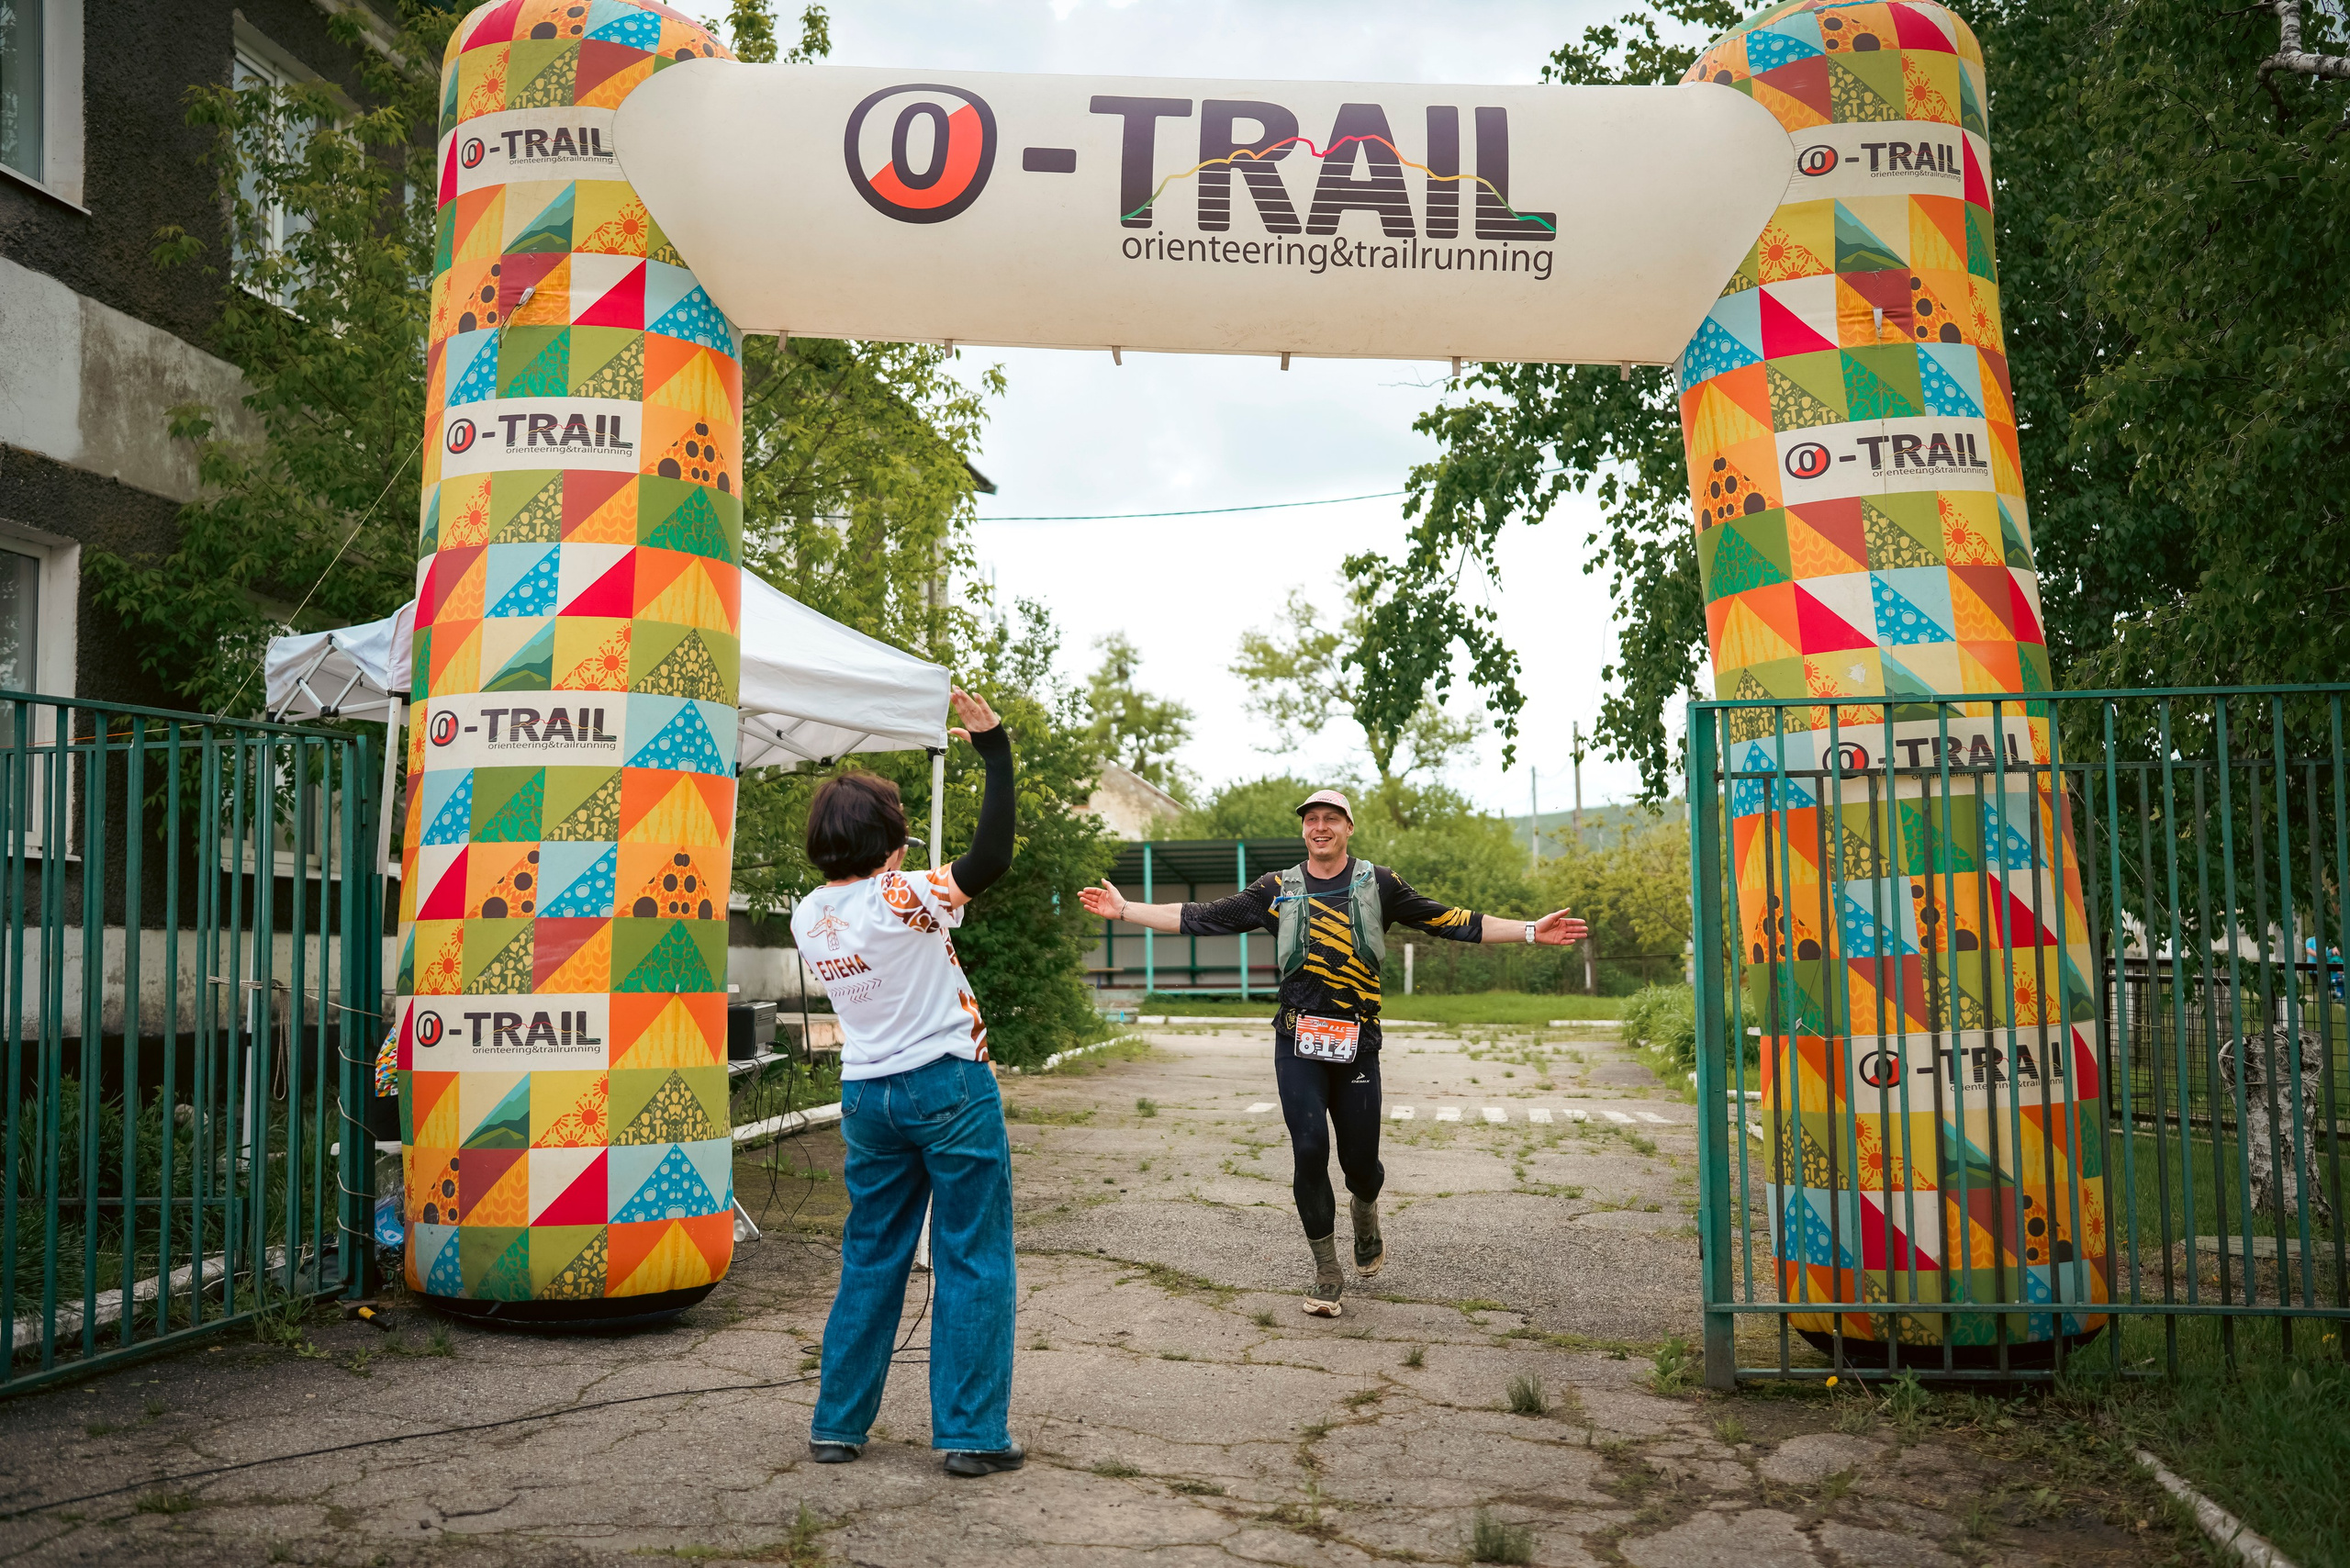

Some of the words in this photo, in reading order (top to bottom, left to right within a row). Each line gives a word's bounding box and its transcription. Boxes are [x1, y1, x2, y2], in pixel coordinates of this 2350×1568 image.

[509, 155, 614, 165] orienteering&trailrunning
[1871, 169, 1962, 183] orienteering&trailrunning
[1121, 231, 1555, 280] orienteering&trailrunning
[506, 445, 633, 457] orienteering&trailrunning
[1872, 465, 1988, 477] orenteering&trailrunning
[487, 741, 617, 751] orienteering&trailrunning
[816, 953, 872, 981] ЕЛЕНА
[472, 1045, 601, 1056] orienteering&trailrunning
[1298, 1032, 1353, 1059] 814
